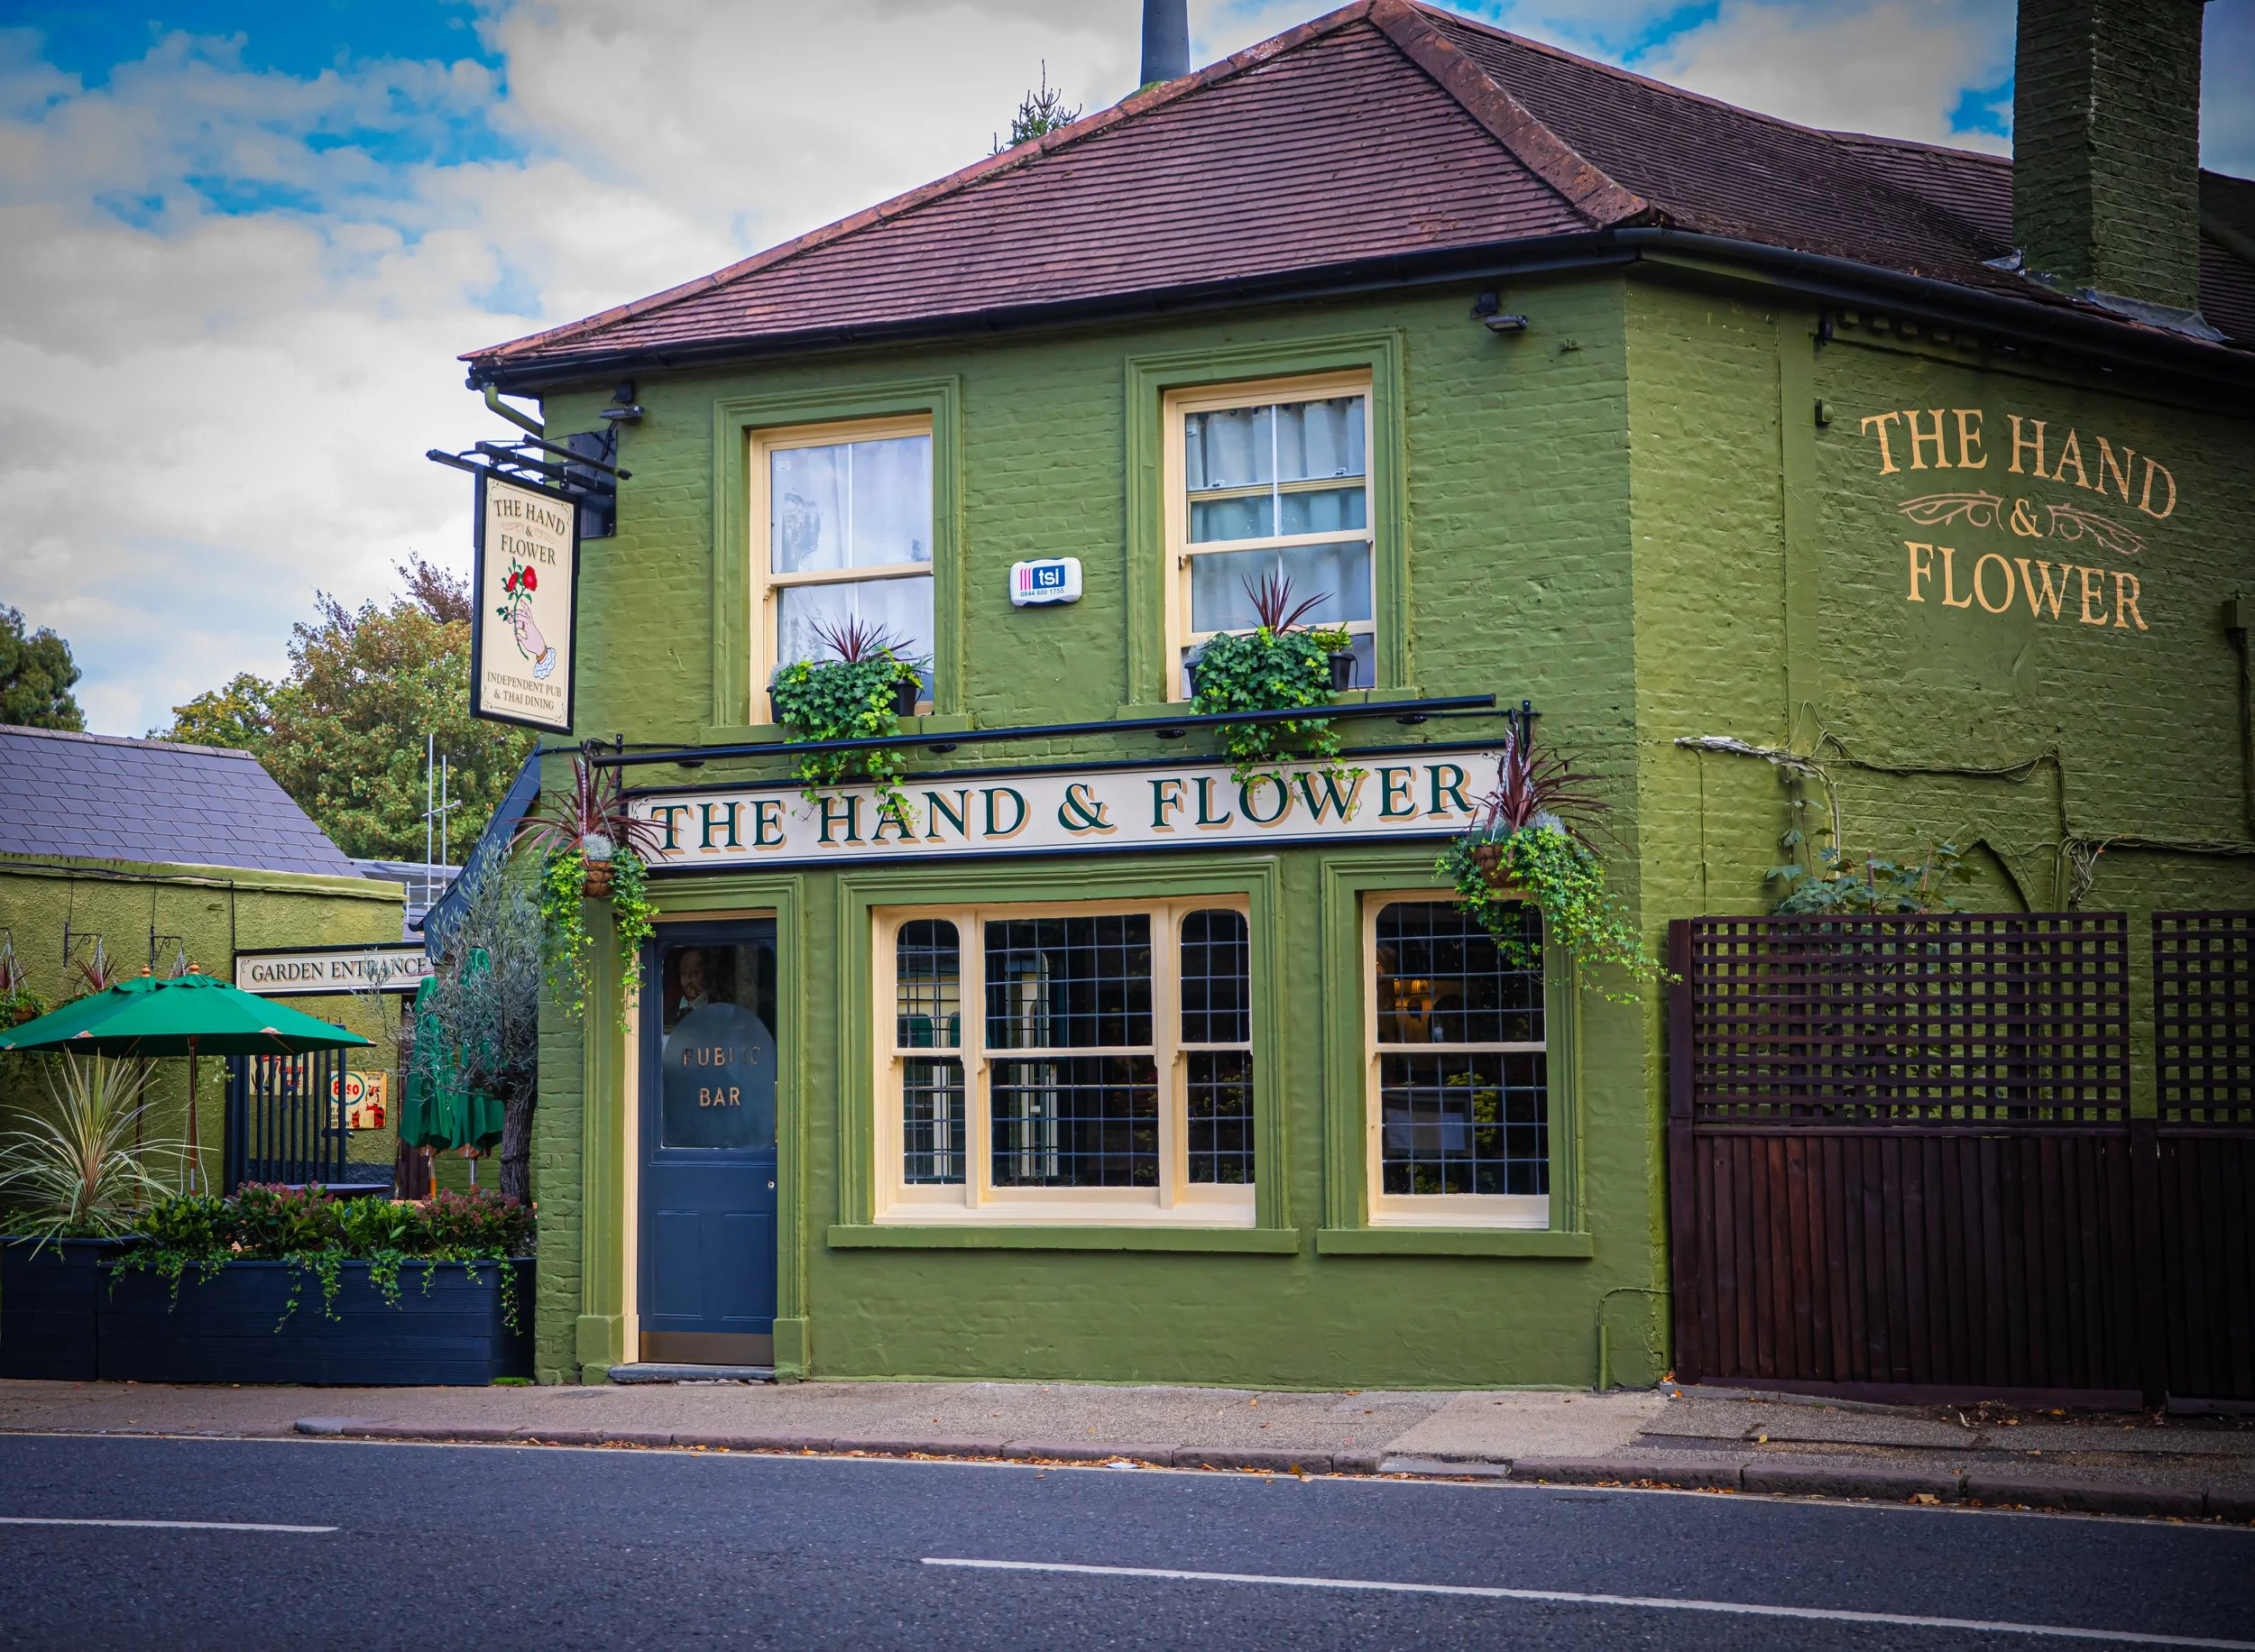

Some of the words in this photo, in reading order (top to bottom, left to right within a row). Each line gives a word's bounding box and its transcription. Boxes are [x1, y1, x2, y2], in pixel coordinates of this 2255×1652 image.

[1861, 408, 1987, 475] THE
[2007, 414, 2177, 519] HAND
[493, 499, 522, 519] THE
[525, 501, 566, 536] HAND
[525, 524, 534, 538] &
[2010, 498, 2043, 537] &
[501, 534, 557, 566] FLOWER
[1903, 541, 2149, 630] FLOWER
[487, 671, 545, 693] INDEPENDENT
[546, 684, 562, 698] PUB
[493, 689, 501, 699] &
[502, 690, 523, 704] THAI
[525, 694, 554, 711] DINING
[649, 799, 787, 855] THE
[816, 786, 1032, 849] HAND
[1057, 783, 1118, 837] &
[1147, 764, 1480, 833] FLOWER
[251, 961, 326, 983] GARDEN
[333, 1080, 360, 1096] Eso
[699, 1087, 741, 1106] BAR
